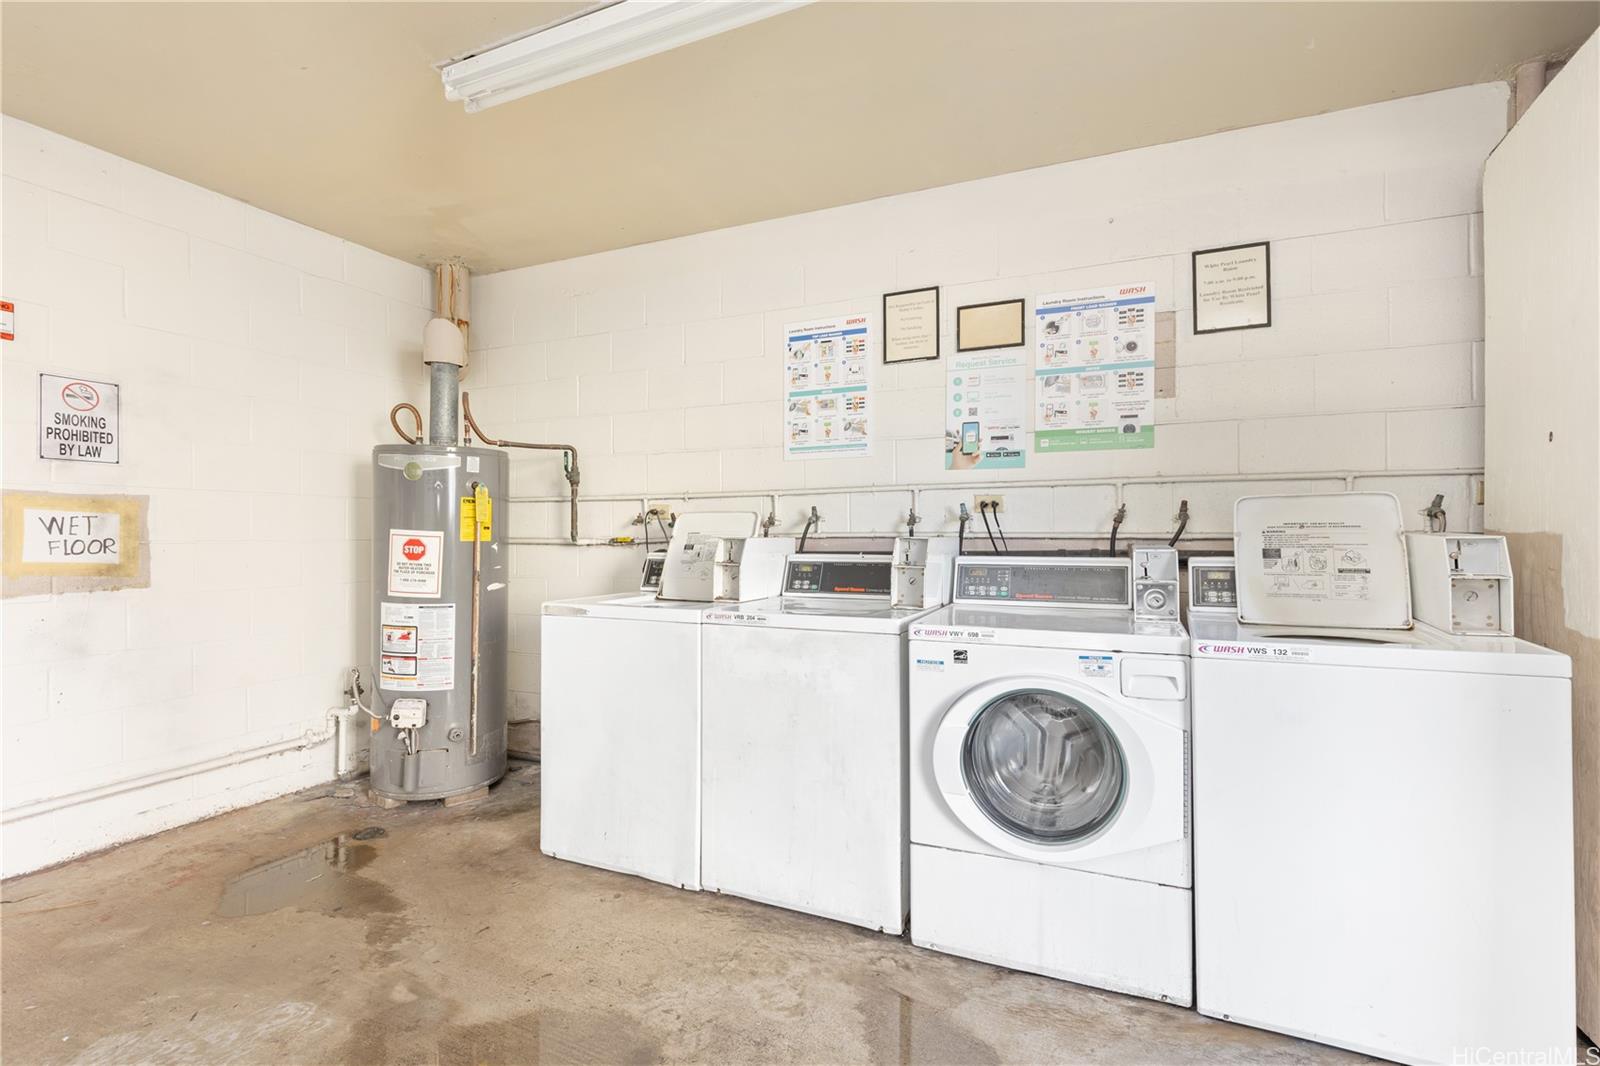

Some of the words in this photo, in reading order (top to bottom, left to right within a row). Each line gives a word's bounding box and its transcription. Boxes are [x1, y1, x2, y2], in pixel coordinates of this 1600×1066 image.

[1119, 286, 1146, 296] WASH
[955, 360, 986, 369] Request
[988, 358, 1017, 366] Service
[54, 412, 106, 430] SMOKING
[46, 427, 114, 445] PROHIBITED
[59, 443, 74, 456] BY
[77, 445, 103, 459] LAW
[38, 514, 99, 537] WET
[48, 538, 118, 557] FLOOR
[404, 545, 425, 554] STOP
[924, 629, 948, 637] WASH
[1213, 645, 1245, 654] WASH
[1246, 647, 1268, 655] VWS
[1273, 648, 1288, 656] 132
